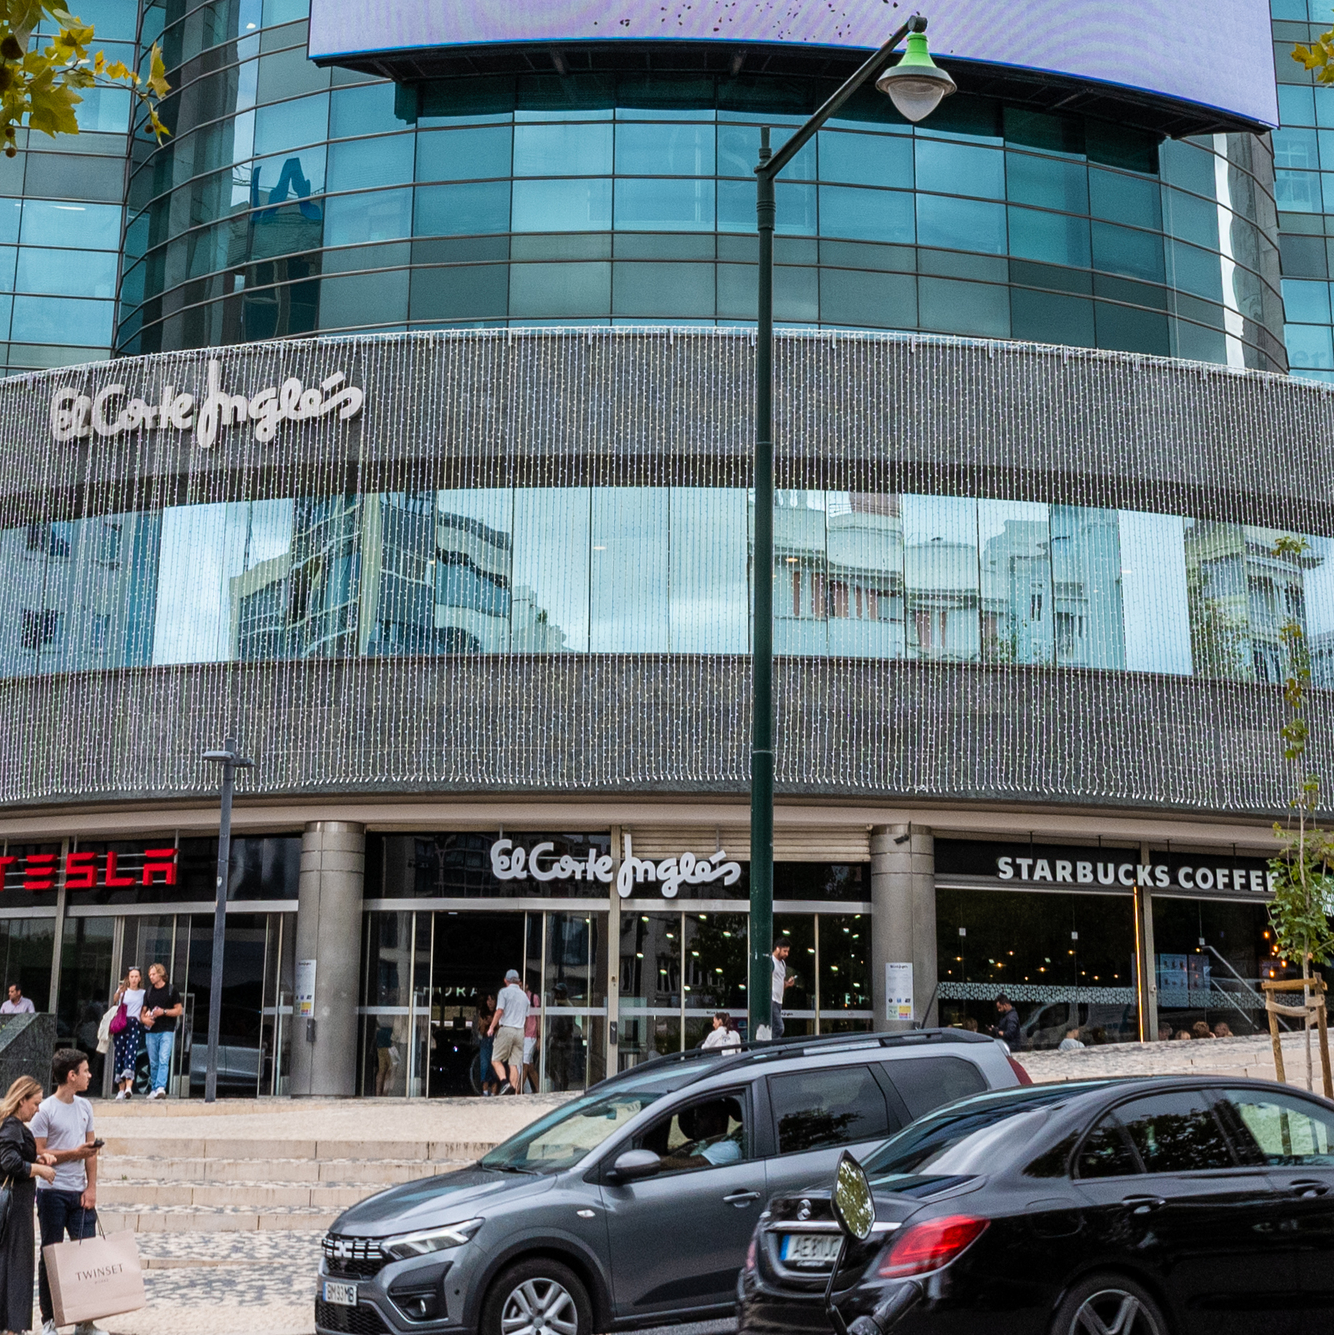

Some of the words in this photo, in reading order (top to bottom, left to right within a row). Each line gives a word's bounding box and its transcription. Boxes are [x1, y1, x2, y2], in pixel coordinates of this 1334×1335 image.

[51, 387, 92, 442] El
[91, 384, 195, 437] Corte
[490, 839, 527, 879] El
[528, 842, 613, 882] Corte
[617, 834, 741, 898] Inglés
[998, 857, 1170, 888] STARBUCKS
[75, 1263, 123, 1281] TWINSET
